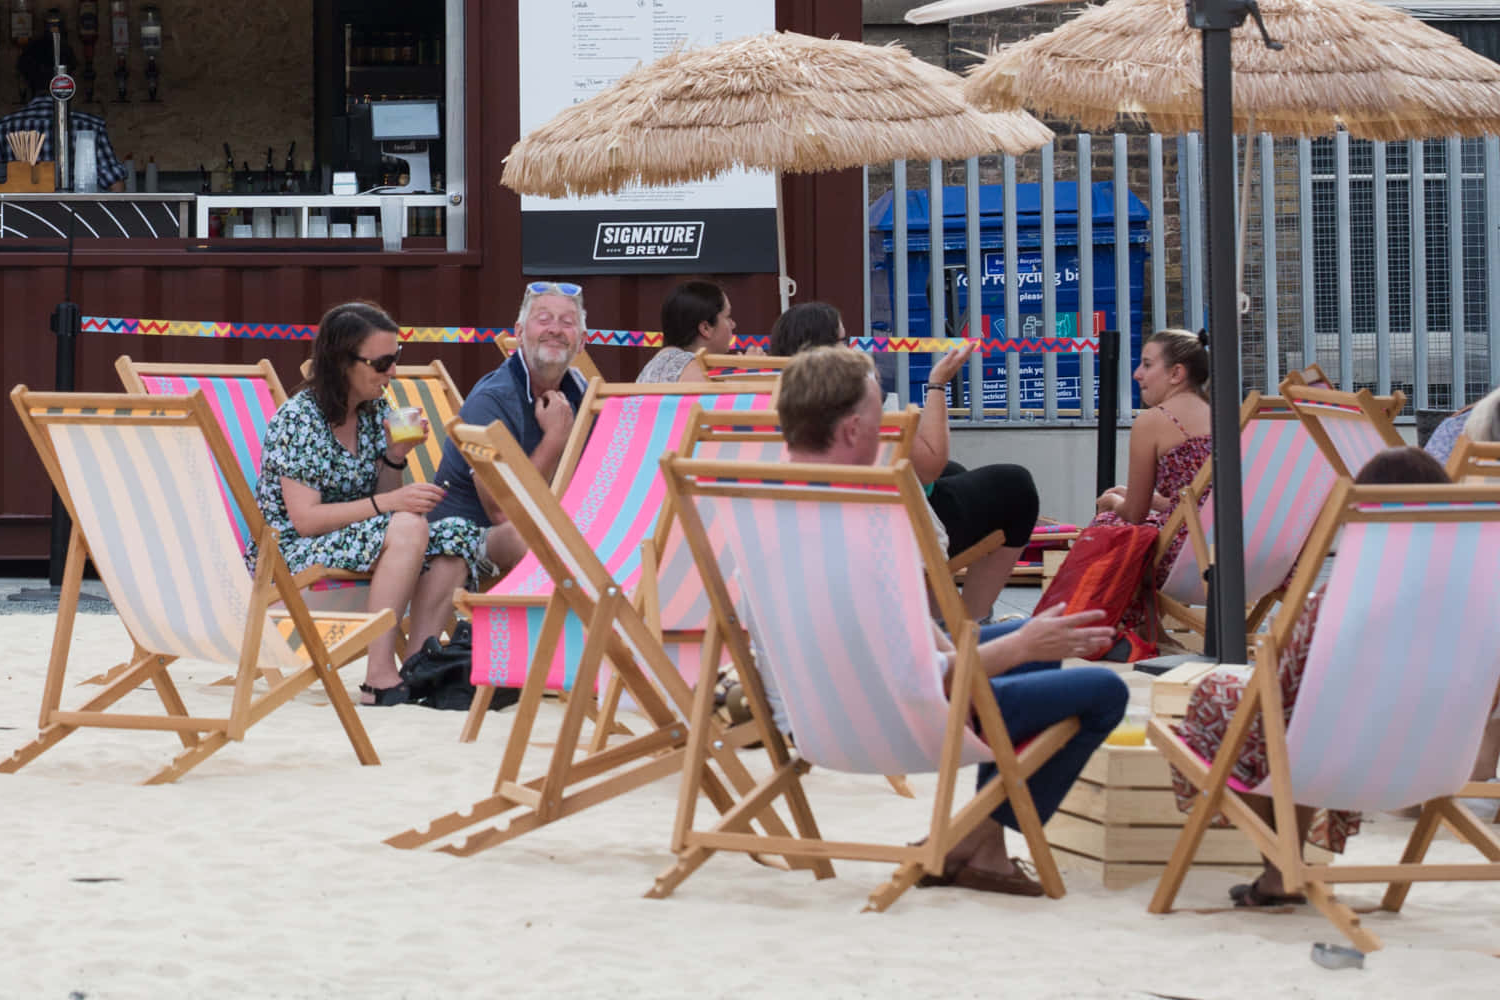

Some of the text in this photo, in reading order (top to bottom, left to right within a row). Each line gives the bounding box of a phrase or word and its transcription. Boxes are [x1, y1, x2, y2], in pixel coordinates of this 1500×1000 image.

[603, 226, 696, 244] SIGNATURE
[625, 245, 669, 255] BREW
[957, 273, 989, 287] Yor
[993, 271, 1062, 287] reyclig
